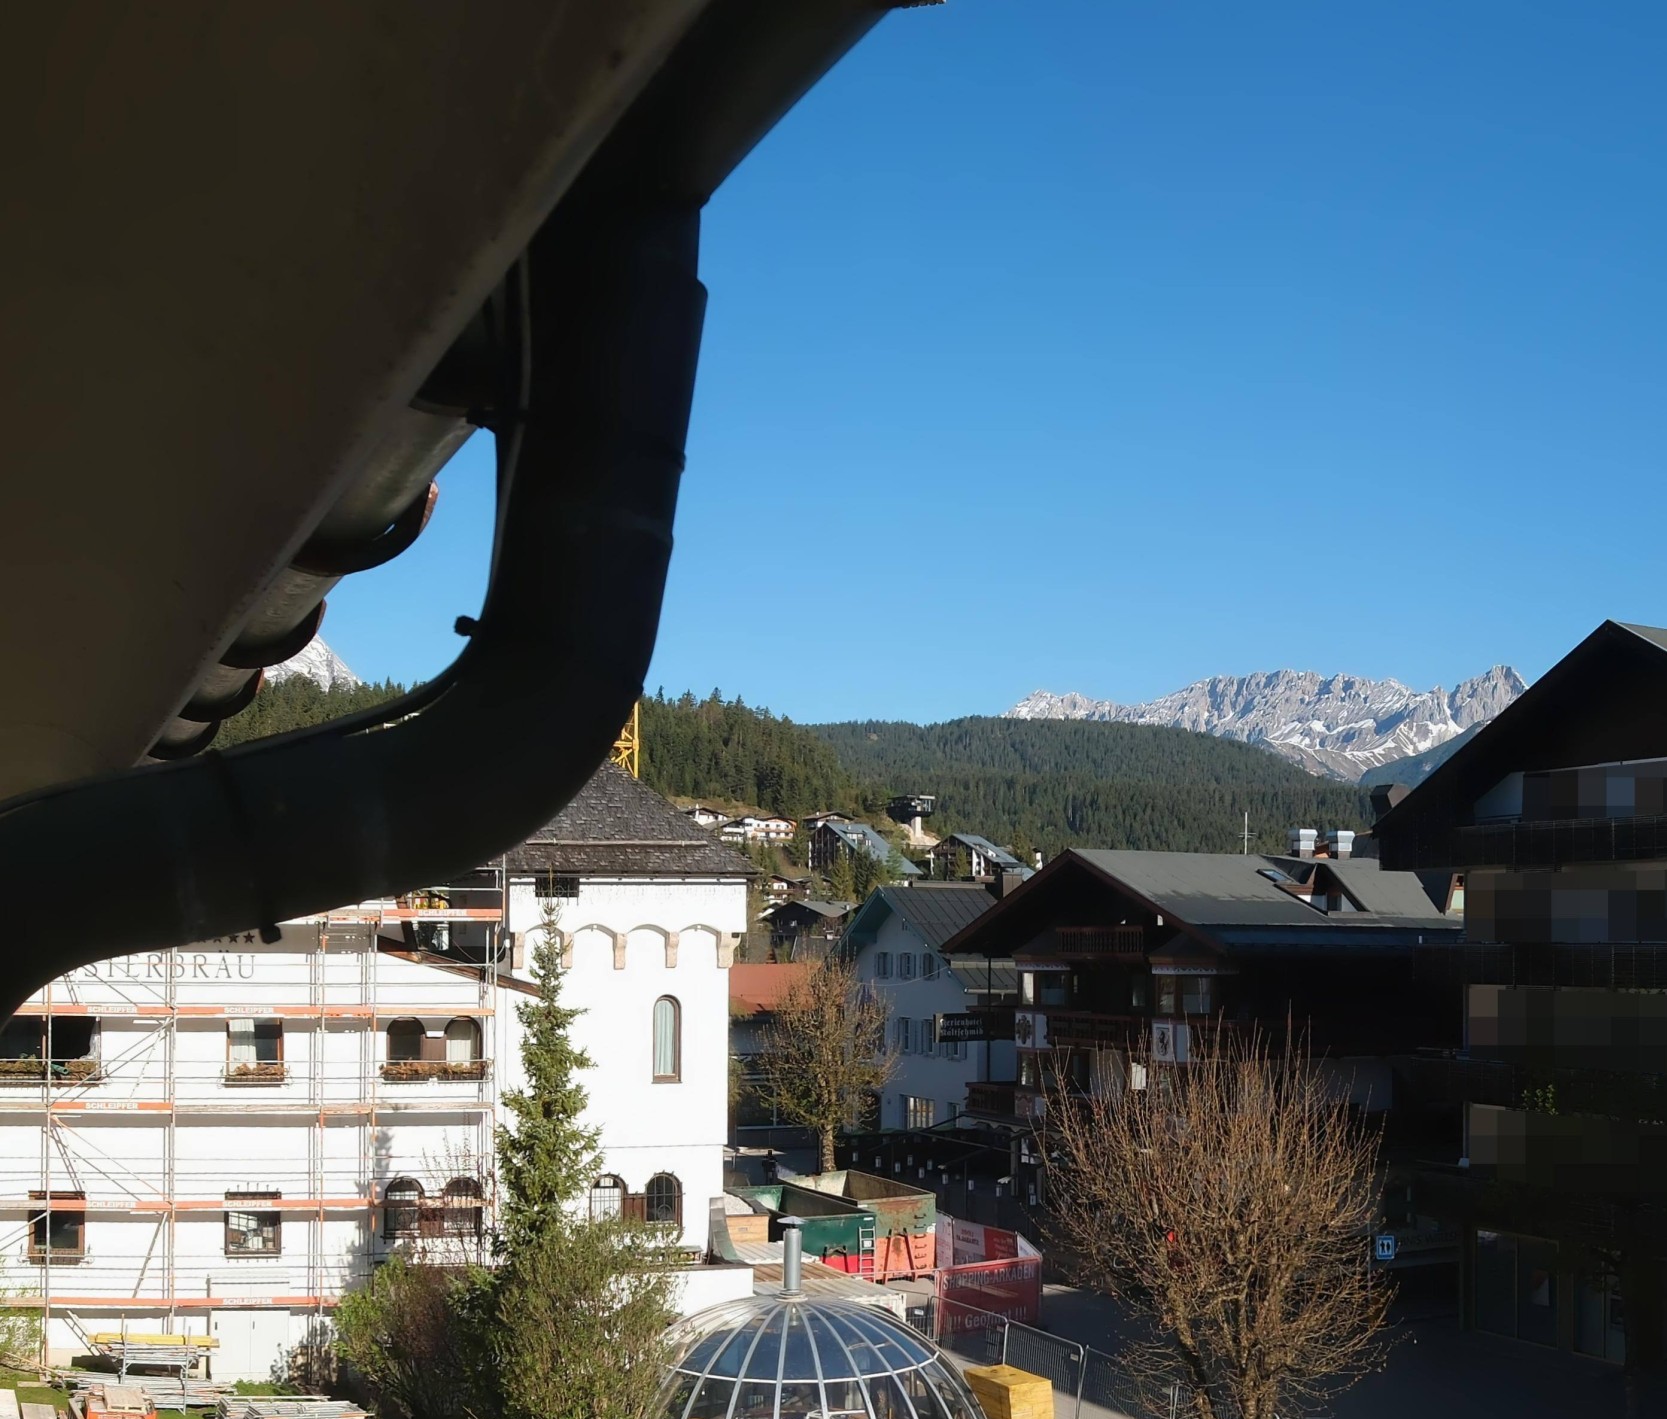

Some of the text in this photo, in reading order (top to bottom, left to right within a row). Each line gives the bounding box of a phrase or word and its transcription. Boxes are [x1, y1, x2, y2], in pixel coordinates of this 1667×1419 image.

[418, 909, 467, 917] SCHLEIPFER
[87, 1006, 138, 1014] SCHLEIPFER
[224, 1006, 275, 1014] SCHLEIPFER
[85, 1102, 138, 1110] SCHLEIPFER
[222, 1200, 273, 1208] SCHLEIPFER
[943, 1263, 1035, 1290] SHOPPING-ARKADEN
